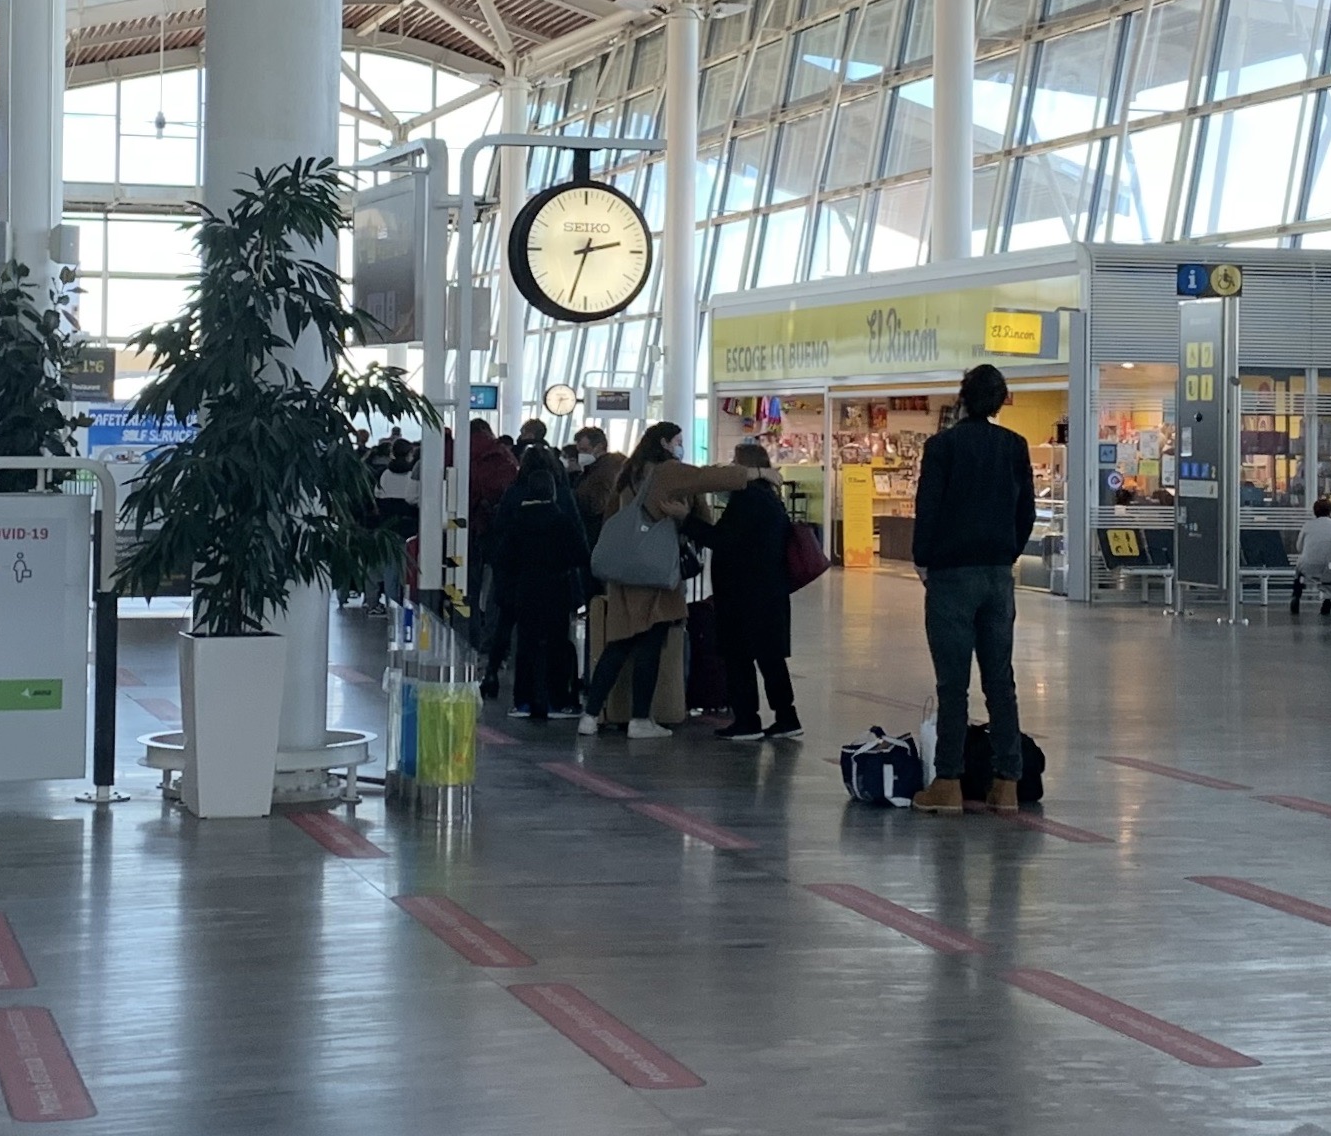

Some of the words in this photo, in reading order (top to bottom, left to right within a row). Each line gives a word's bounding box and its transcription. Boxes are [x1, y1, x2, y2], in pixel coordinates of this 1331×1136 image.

[563, 222, 611, 234] SEIKO
[726, 345, 767, 373] ESCOGE
[770, 344, 785, 370] LO
[789, 340, 830, 370] BUENO
